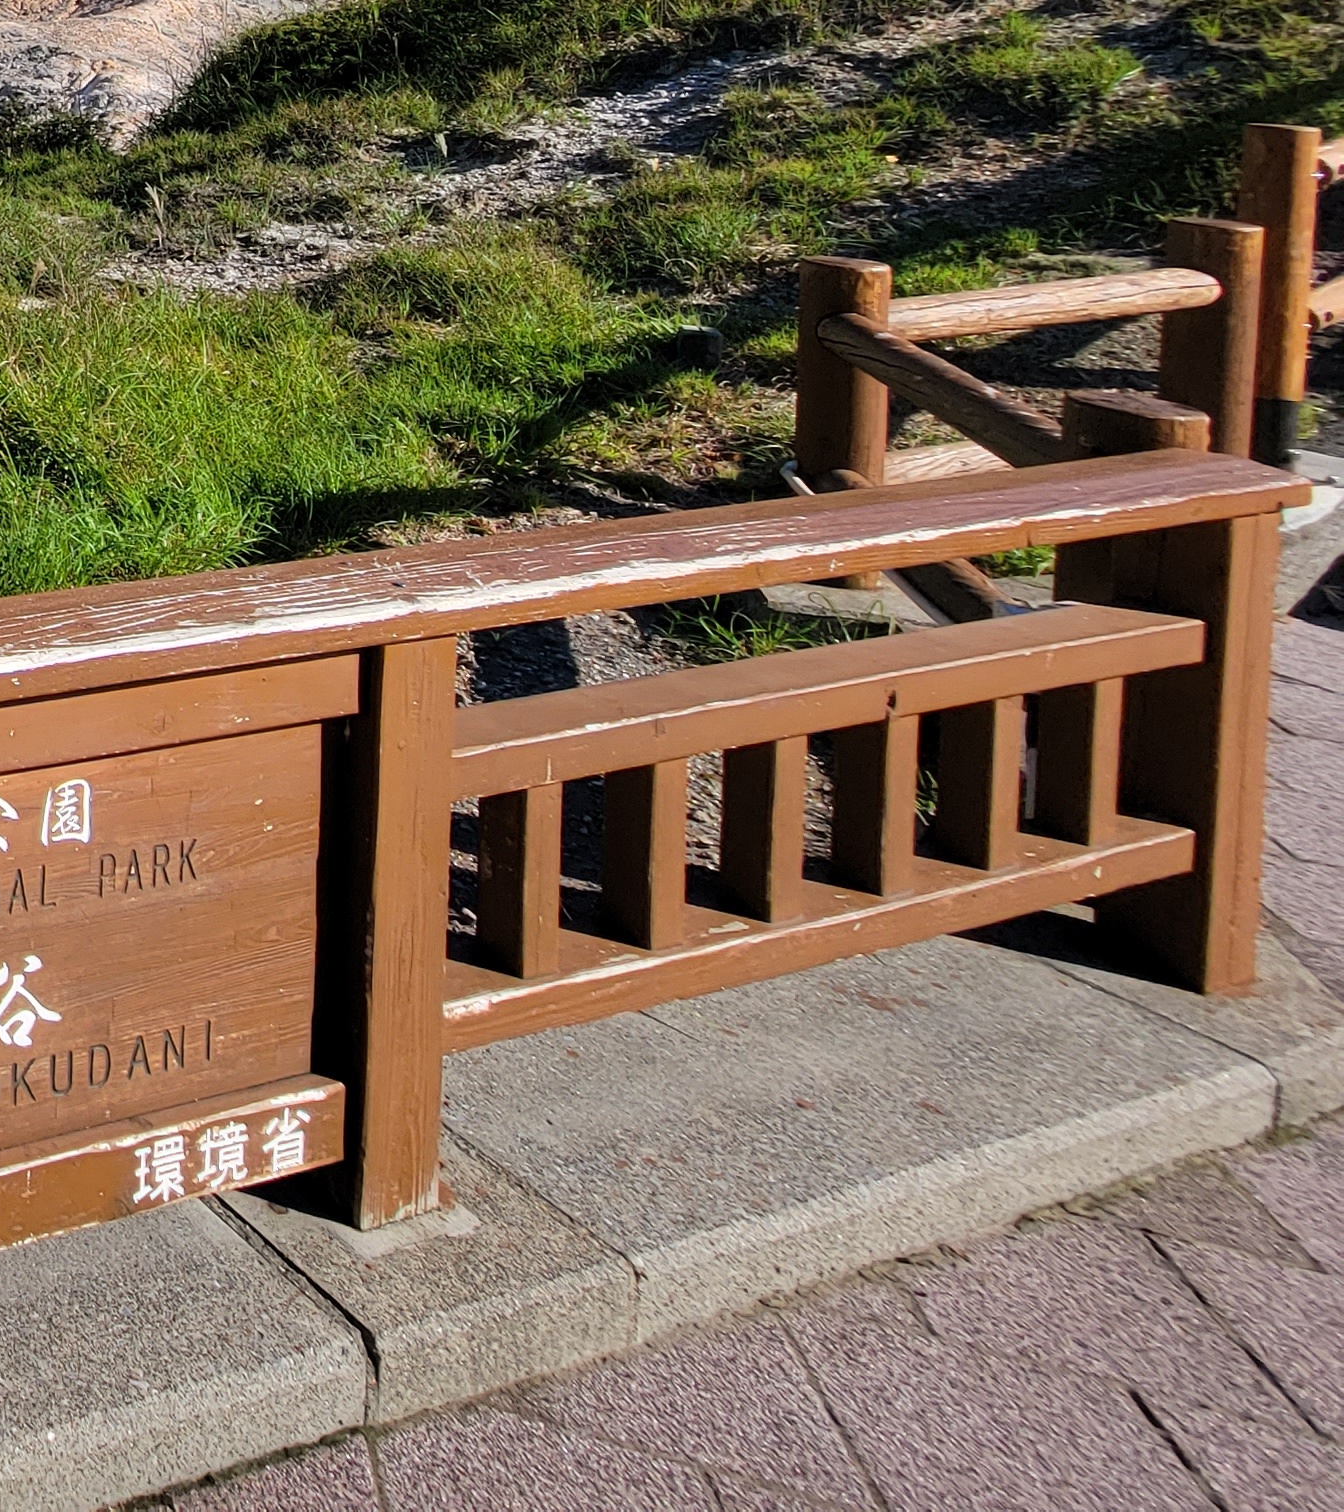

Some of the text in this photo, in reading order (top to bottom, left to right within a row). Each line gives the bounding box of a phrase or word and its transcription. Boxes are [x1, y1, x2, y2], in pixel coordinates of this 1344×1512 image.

[98, 838, 199, 899] PARK
[132, 1107, 312, 1205] 環境省
